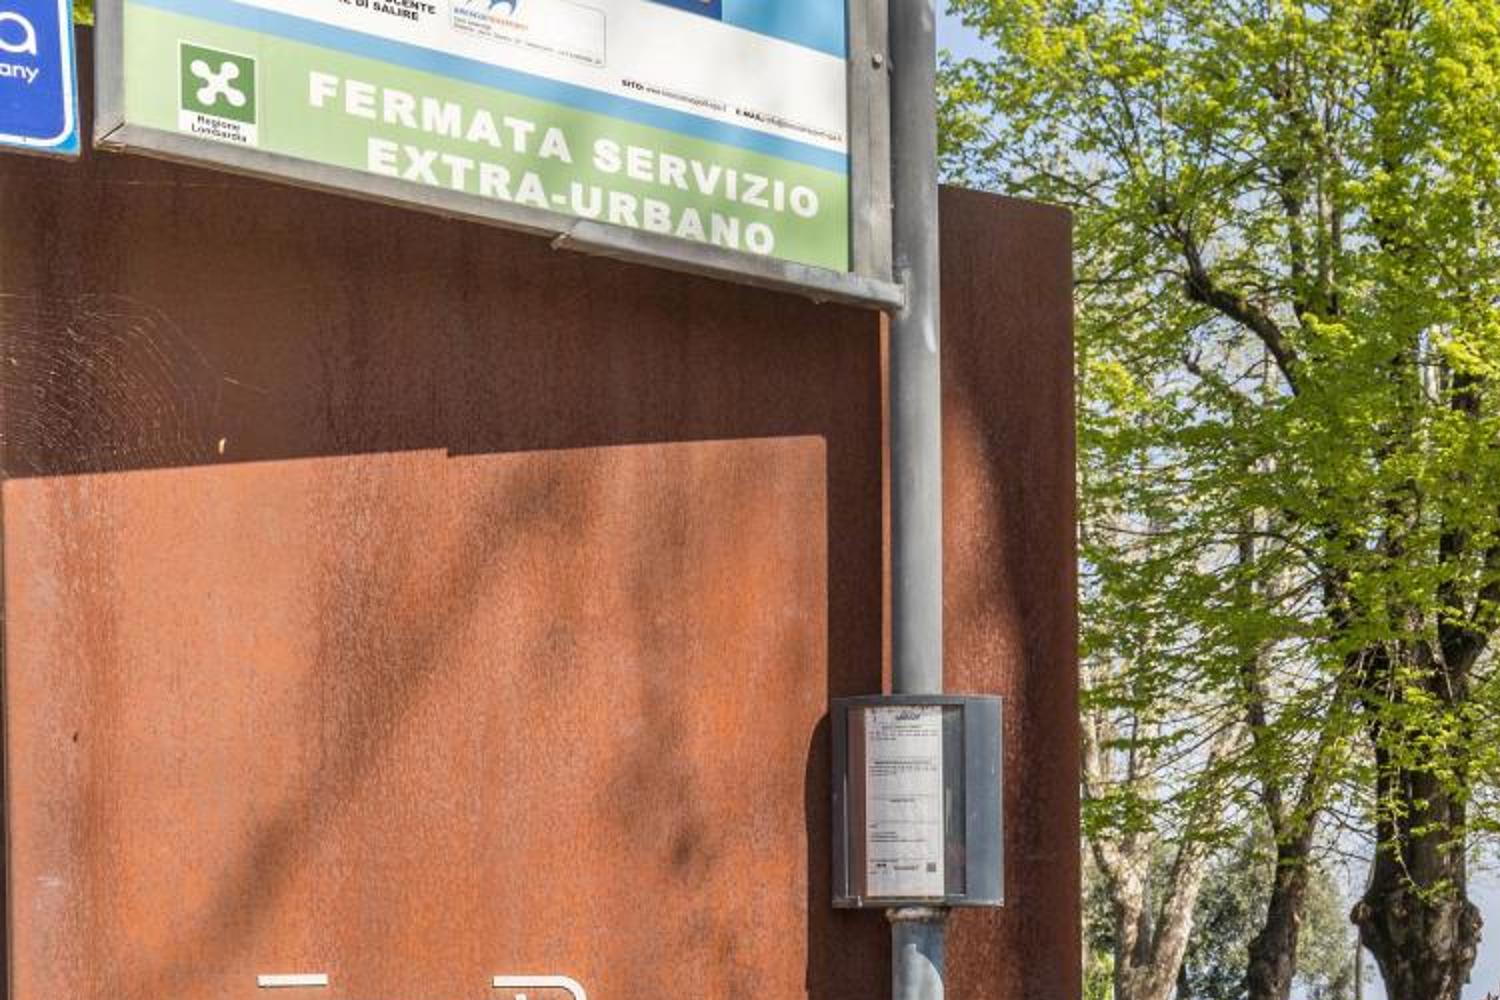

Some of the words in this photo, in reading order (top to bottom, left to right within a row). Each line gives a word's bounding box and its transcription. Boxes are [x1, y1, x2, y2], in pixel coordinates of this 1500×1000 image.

[373, 2, 419, 21] SALIRE
[308, 71, 573, 164] FERMATA
[592, 138, 820, 219] SERVIZIO
[367, 136, 776, 256] EXTRA-URBANO
